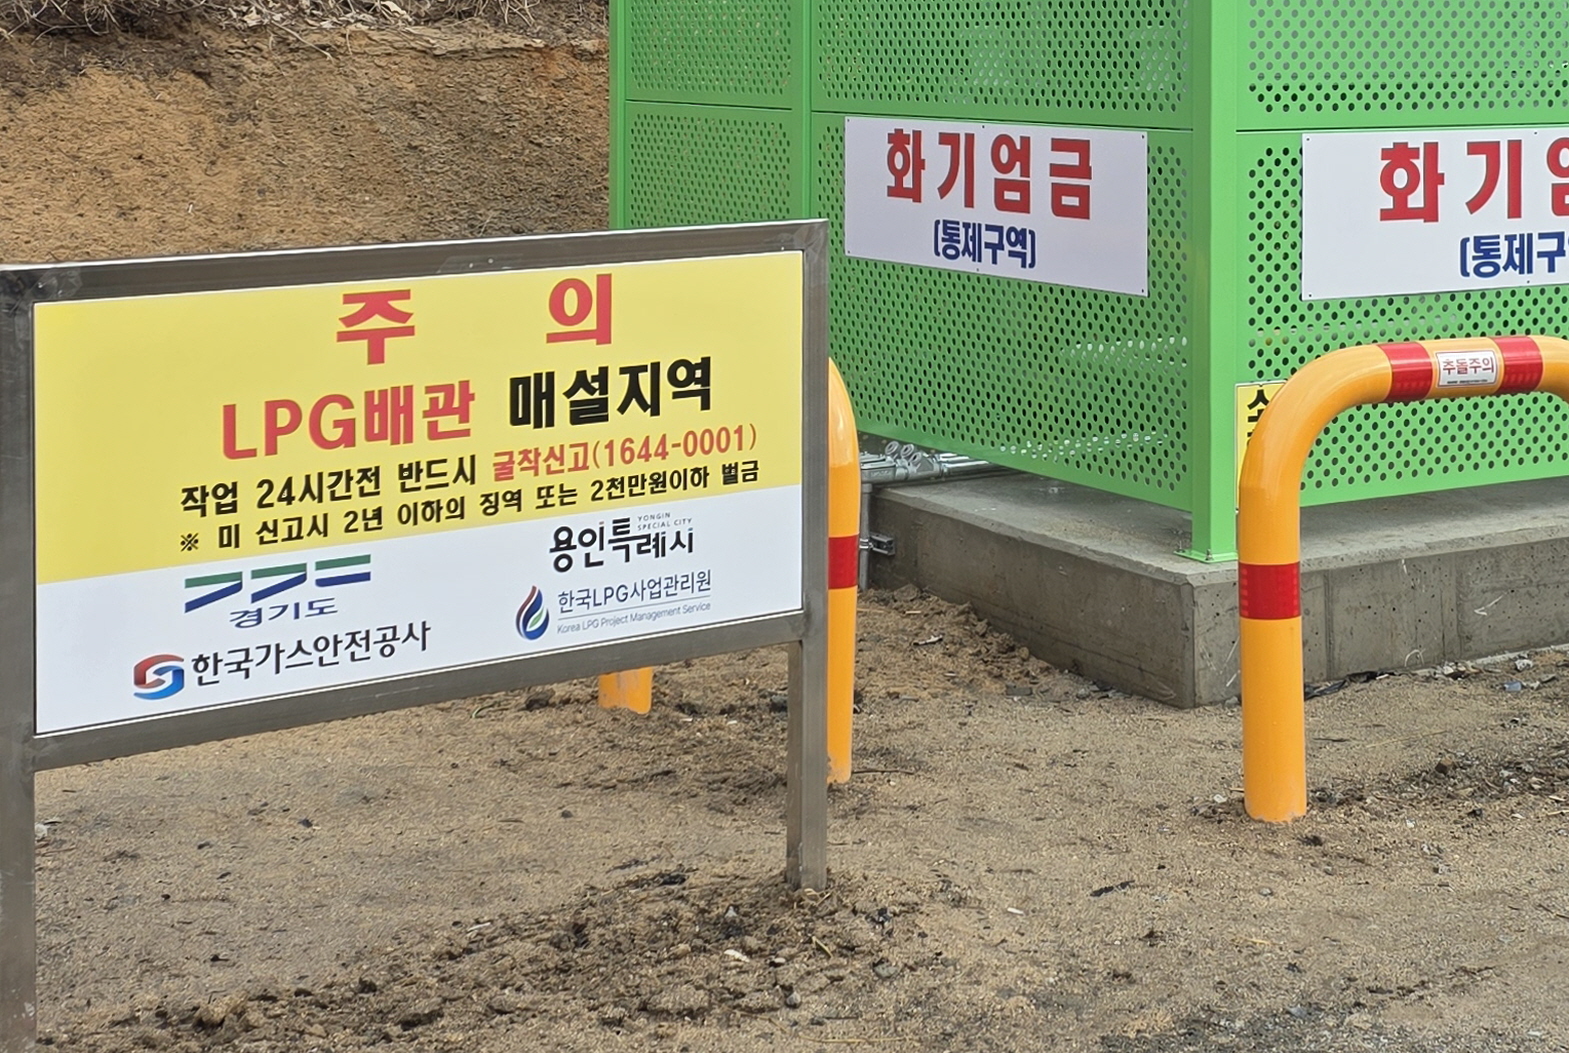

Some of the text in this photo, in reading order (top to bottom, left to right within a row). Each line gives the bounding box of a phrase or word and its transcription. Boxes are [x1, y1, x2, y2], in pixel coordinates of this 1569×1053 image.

[223, 356, 711, 460] LPG배관 매설지역
[180, 423, 757, 517] 작업 24시간전 반드시 굴착신고(1644-0001)
[218, 524, 240, 549] 미
[256, 513, 329, 545] 신고시
[343, 506, 383, 534] 2년
[398, 496, 466, 527] 이하의
[479, 488, 523, 517] 징역
[535, 483, 578, 510] 또는
[590, 466, 710, 501] 2천만원이하
[721, 460, 759, 486] 벌금
[637, 512, 671, 523] YONGIN
[637, 517, 693, 532] SPECIAL CITY
[550, 517, 694, 573] 용인특례시
[230, 598, 338, 629] 경기도
[558, 569, 711, 614] 한국LPG사업관리원
[557, 601, 711, 635] Korea LPG Project Management Service
[191, 620, 431, 686] 한국가스안전공사
